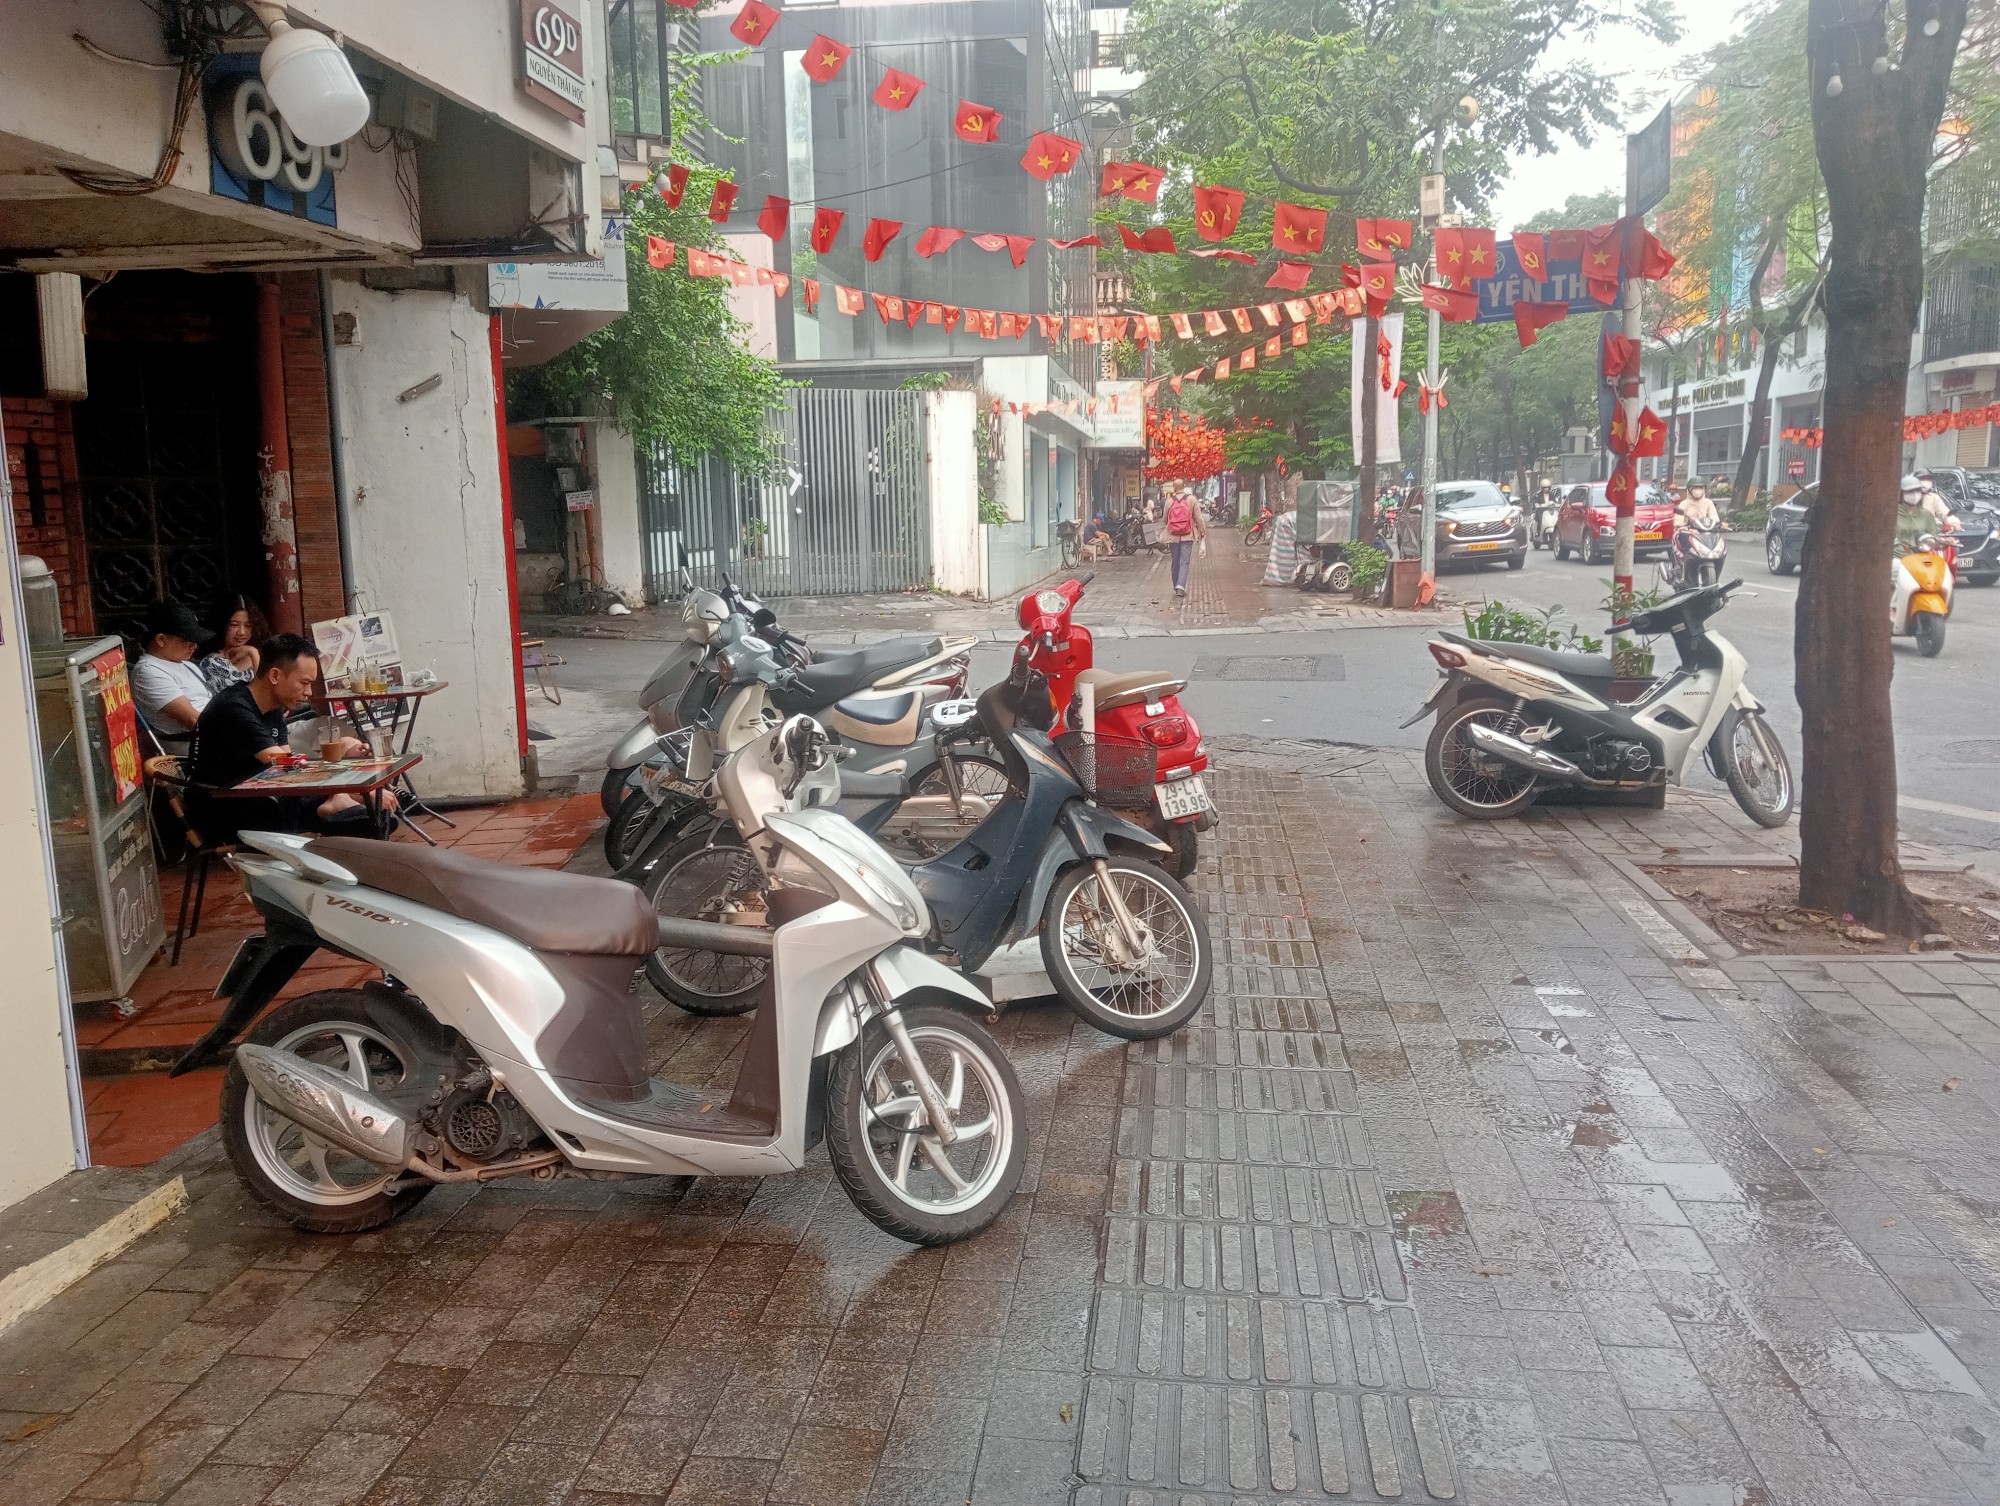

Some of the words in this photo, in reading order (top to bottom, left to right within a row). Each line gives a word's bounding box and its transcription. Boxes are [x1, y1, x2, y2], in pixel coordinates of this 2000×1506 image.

[535, 6, 577, 57] 69D
[1487, 273, 1542, 308] YÊN
[1551, 272, 1590, 301] TH
[1164, 794, 1207, 817] 139.96
